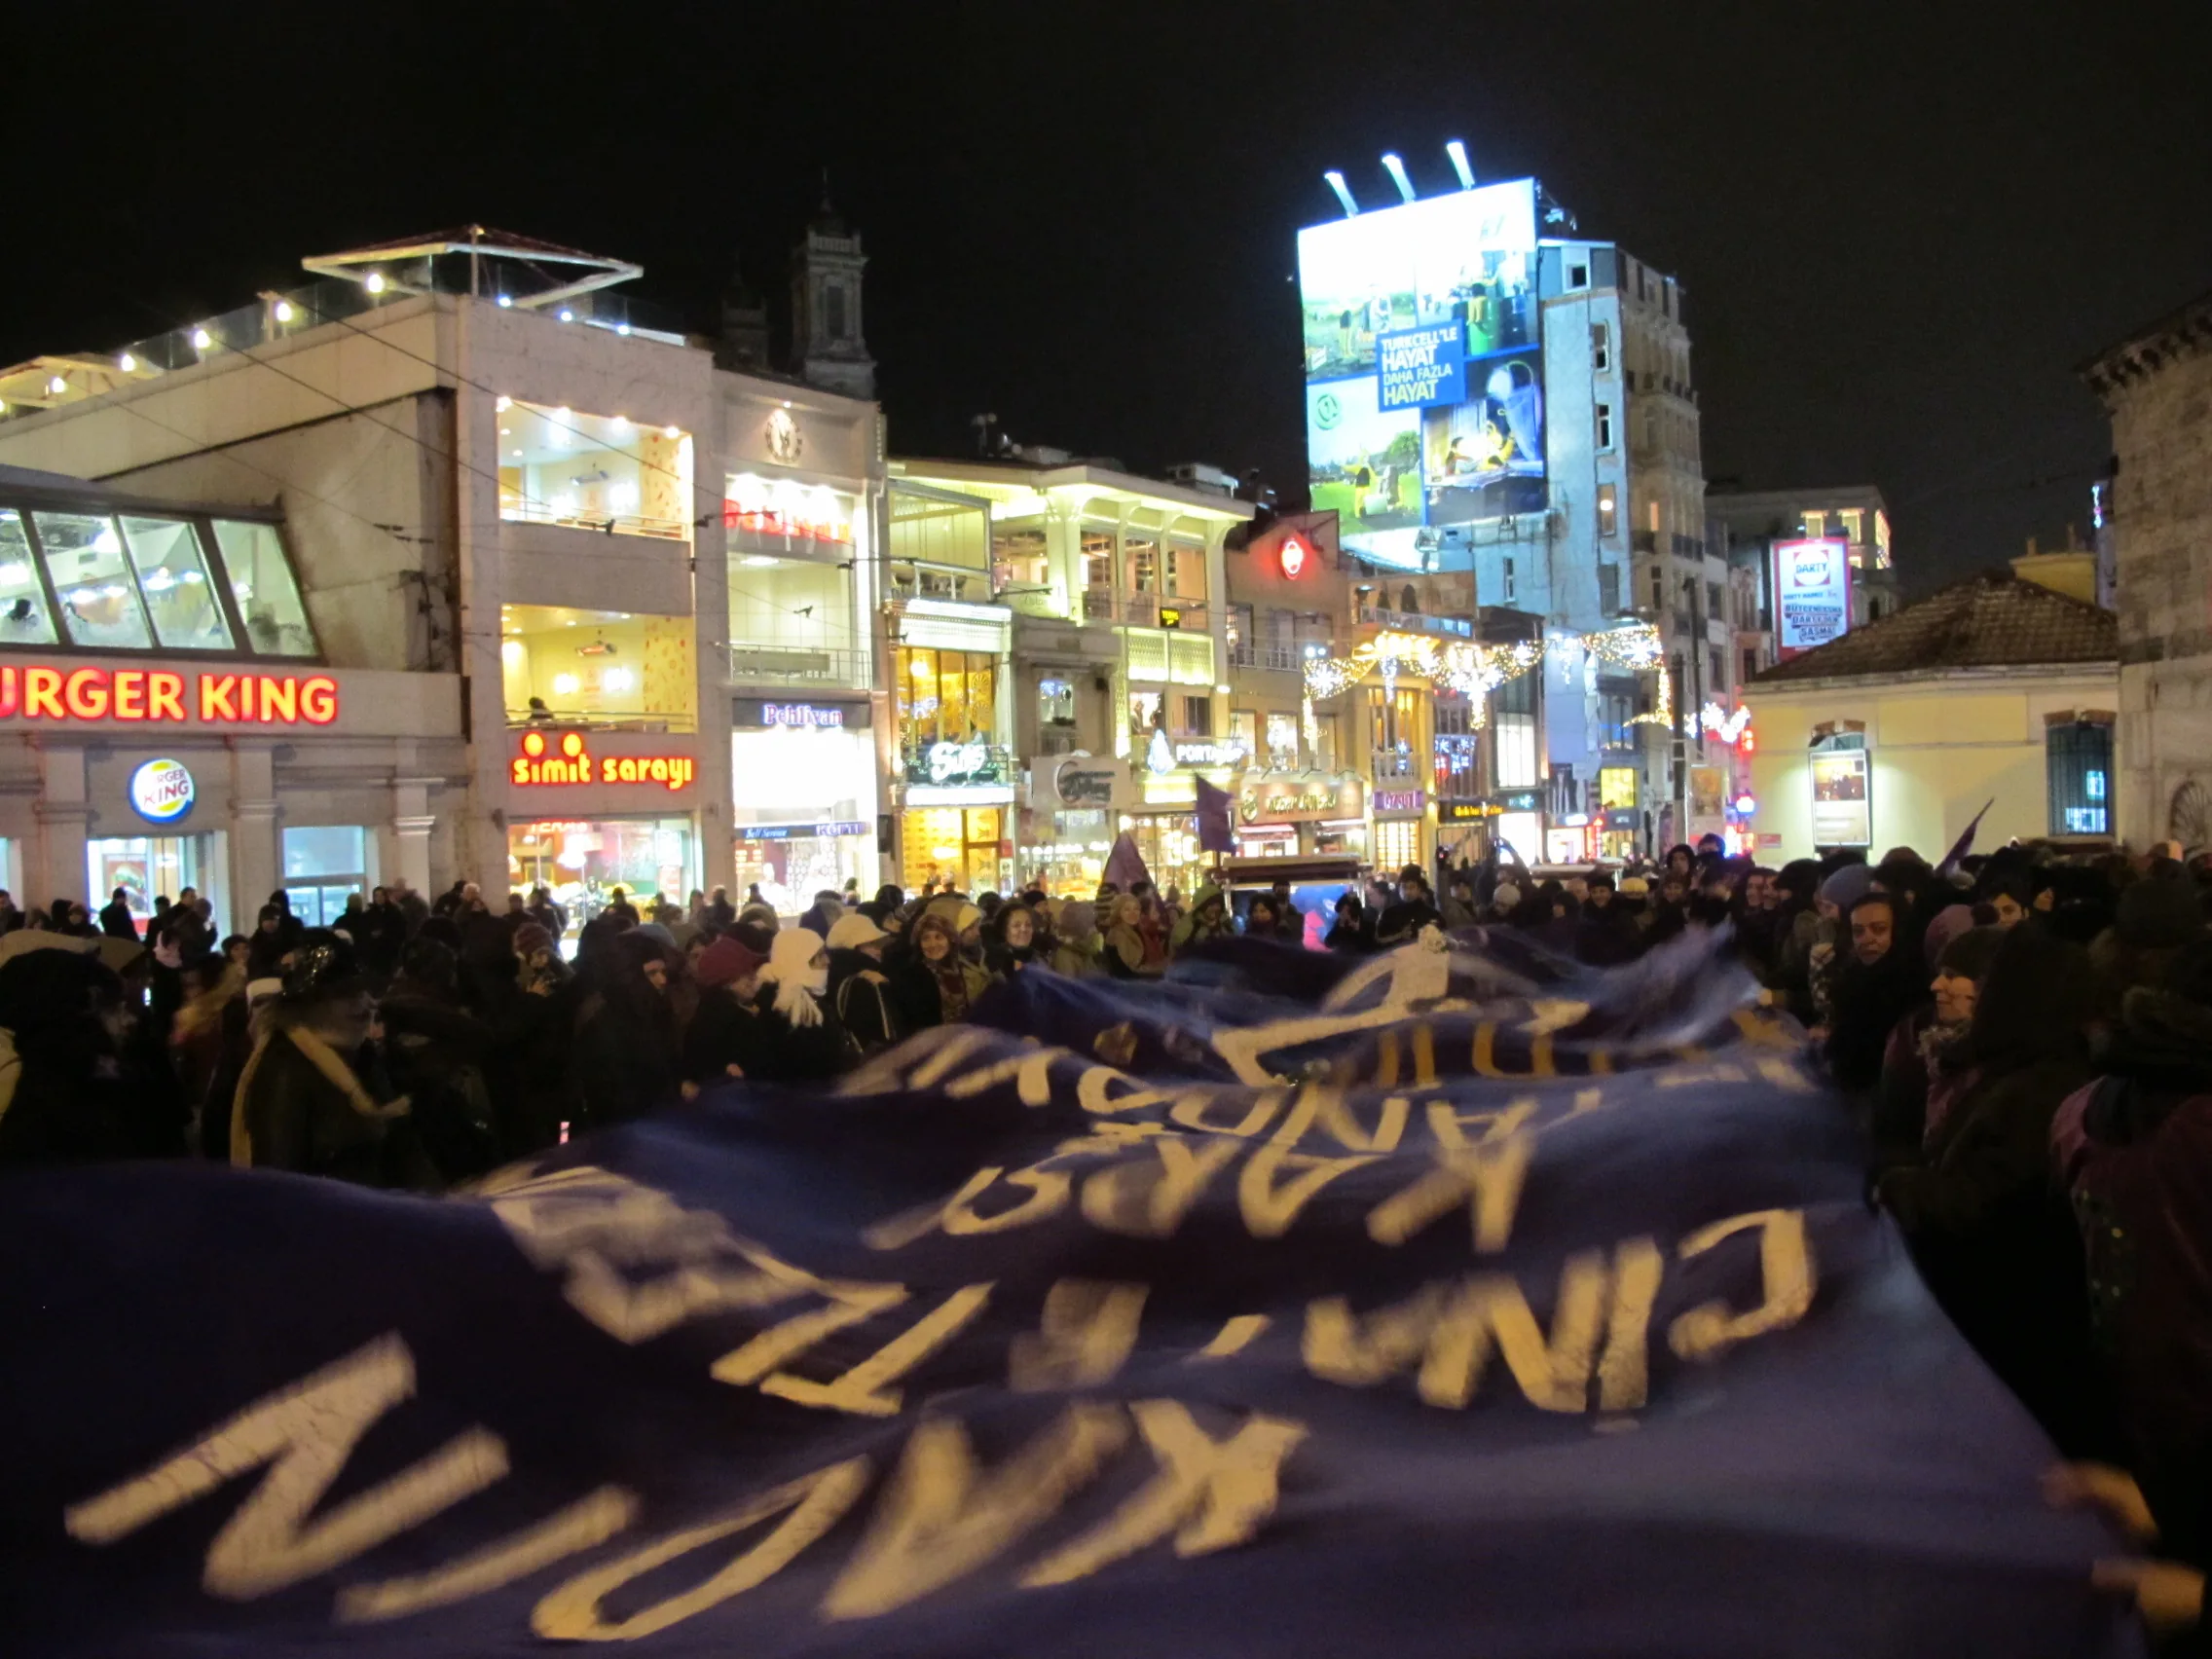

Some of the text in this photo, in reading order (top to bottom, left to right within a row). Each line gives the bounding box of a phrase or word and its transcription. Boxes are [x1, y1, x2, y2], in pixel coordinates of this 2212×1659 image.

[1382, 345, 1438, 373] HAYAT
[1383, 362, 1454, 387] DAHA FAZLA
[1383, 379, 1439, 407] HAYAT
[1795, 563, 1828, 574] DARTY
[199, 672, 337, 724] KING
[763, 703, 843, 725] Pehlivan
[512, 732, 592, 785] simit
[156, 768, 187, 784] RGER
[143, 779, 189, 809] KING
